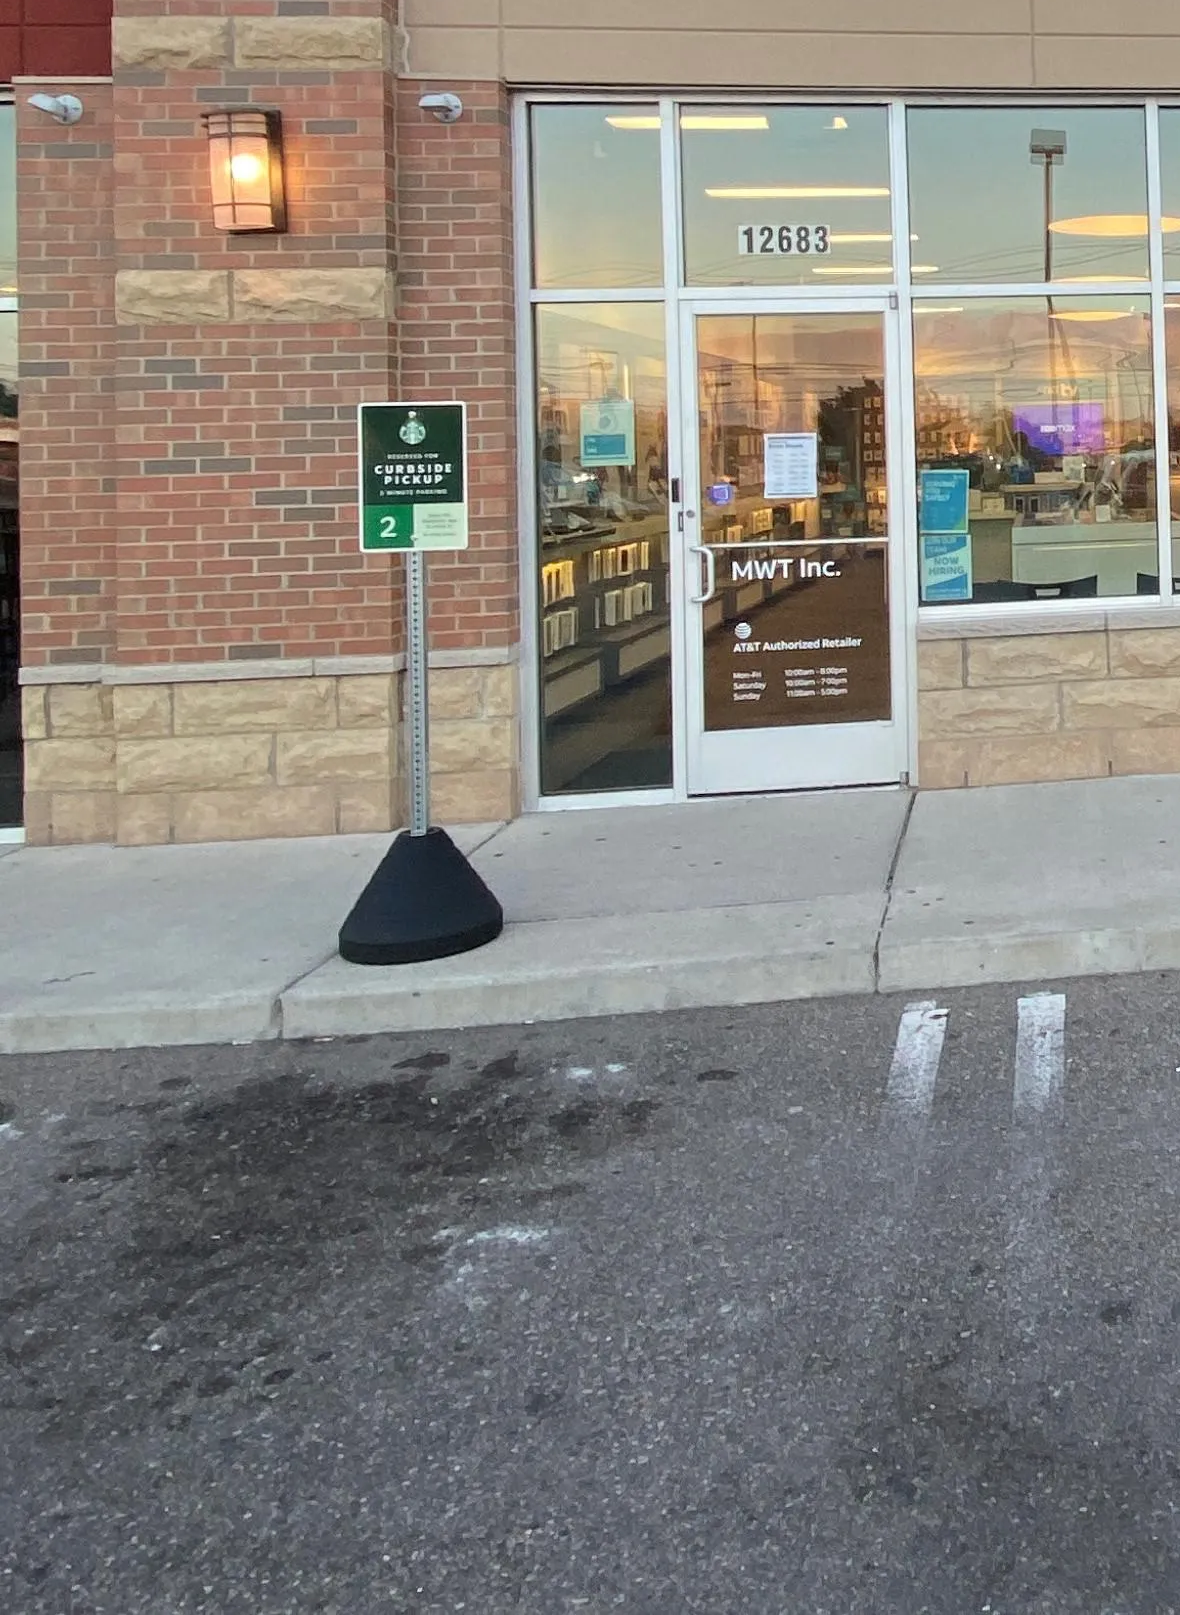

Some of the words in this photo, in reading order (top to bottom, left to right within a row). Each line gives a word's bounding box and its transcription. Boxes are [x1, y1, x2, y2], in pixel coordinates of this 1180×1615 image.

[743, 226, 828, 253] 12683
[374, 463, 452, 475] CURBSIDE
[384, 474, 443, 485] PICKUP
[379, 516, 397, 538] 2
[934, 557, 959, 566] NOW
[731, 558, 795, 581] MWT
[799, 558, 842, 578] Inc.
[928, 566, 965, 576] HIRING
[733, 642, 762, 653] AT&T
[762, 639, 820, 652] Authorized
[822, 636, 863, 648] Retailer
